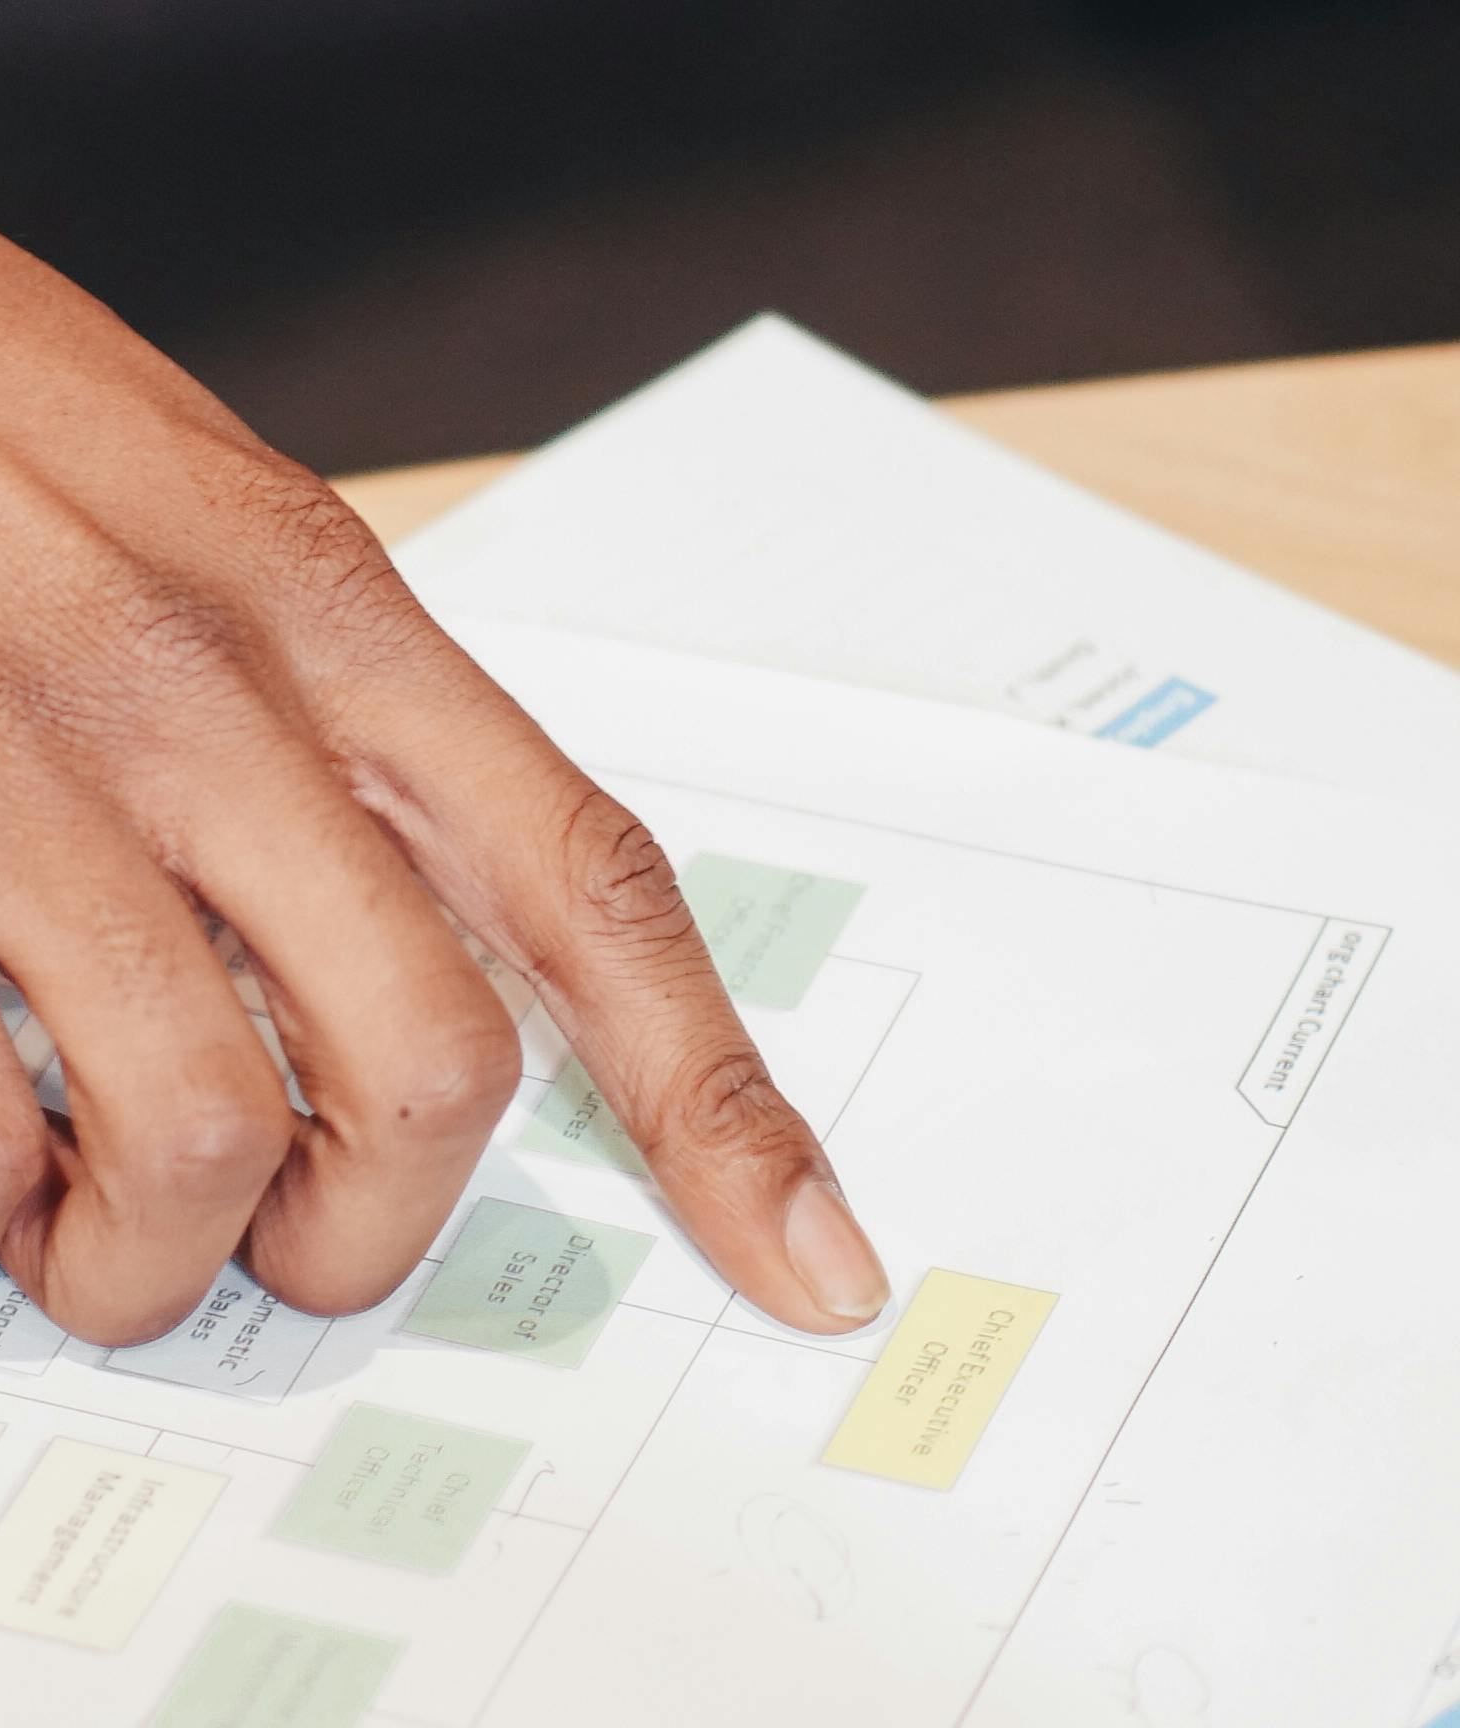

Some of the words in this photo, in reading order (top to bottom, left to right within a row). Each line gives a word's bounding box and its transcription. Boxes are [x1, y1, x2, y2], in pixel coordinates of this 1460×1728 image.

[1325, 929, 1364, 964] org
[1304, 965, 1350, 1016] chart
[1263, 1017, 1323, 1092] Current
[485, 1250, 537, 1306] Sales
[525, 1234, 594, 1318] Director
[189, 1286, 243, 1342] Sales
[512, 1318, 543, 1341] of
[965, 1307, 1016, 1362] Chief
[891, 1338, 950, 1407] Officer
[910, 1361, 985, 1459] Executive
[330, 1443, 393, 1511] Officer
[363, 1439, 445, 1537] Technical
[14, 1469, 122, 1609] Management
[53, 1475, 167, 1621] Infrastructure
